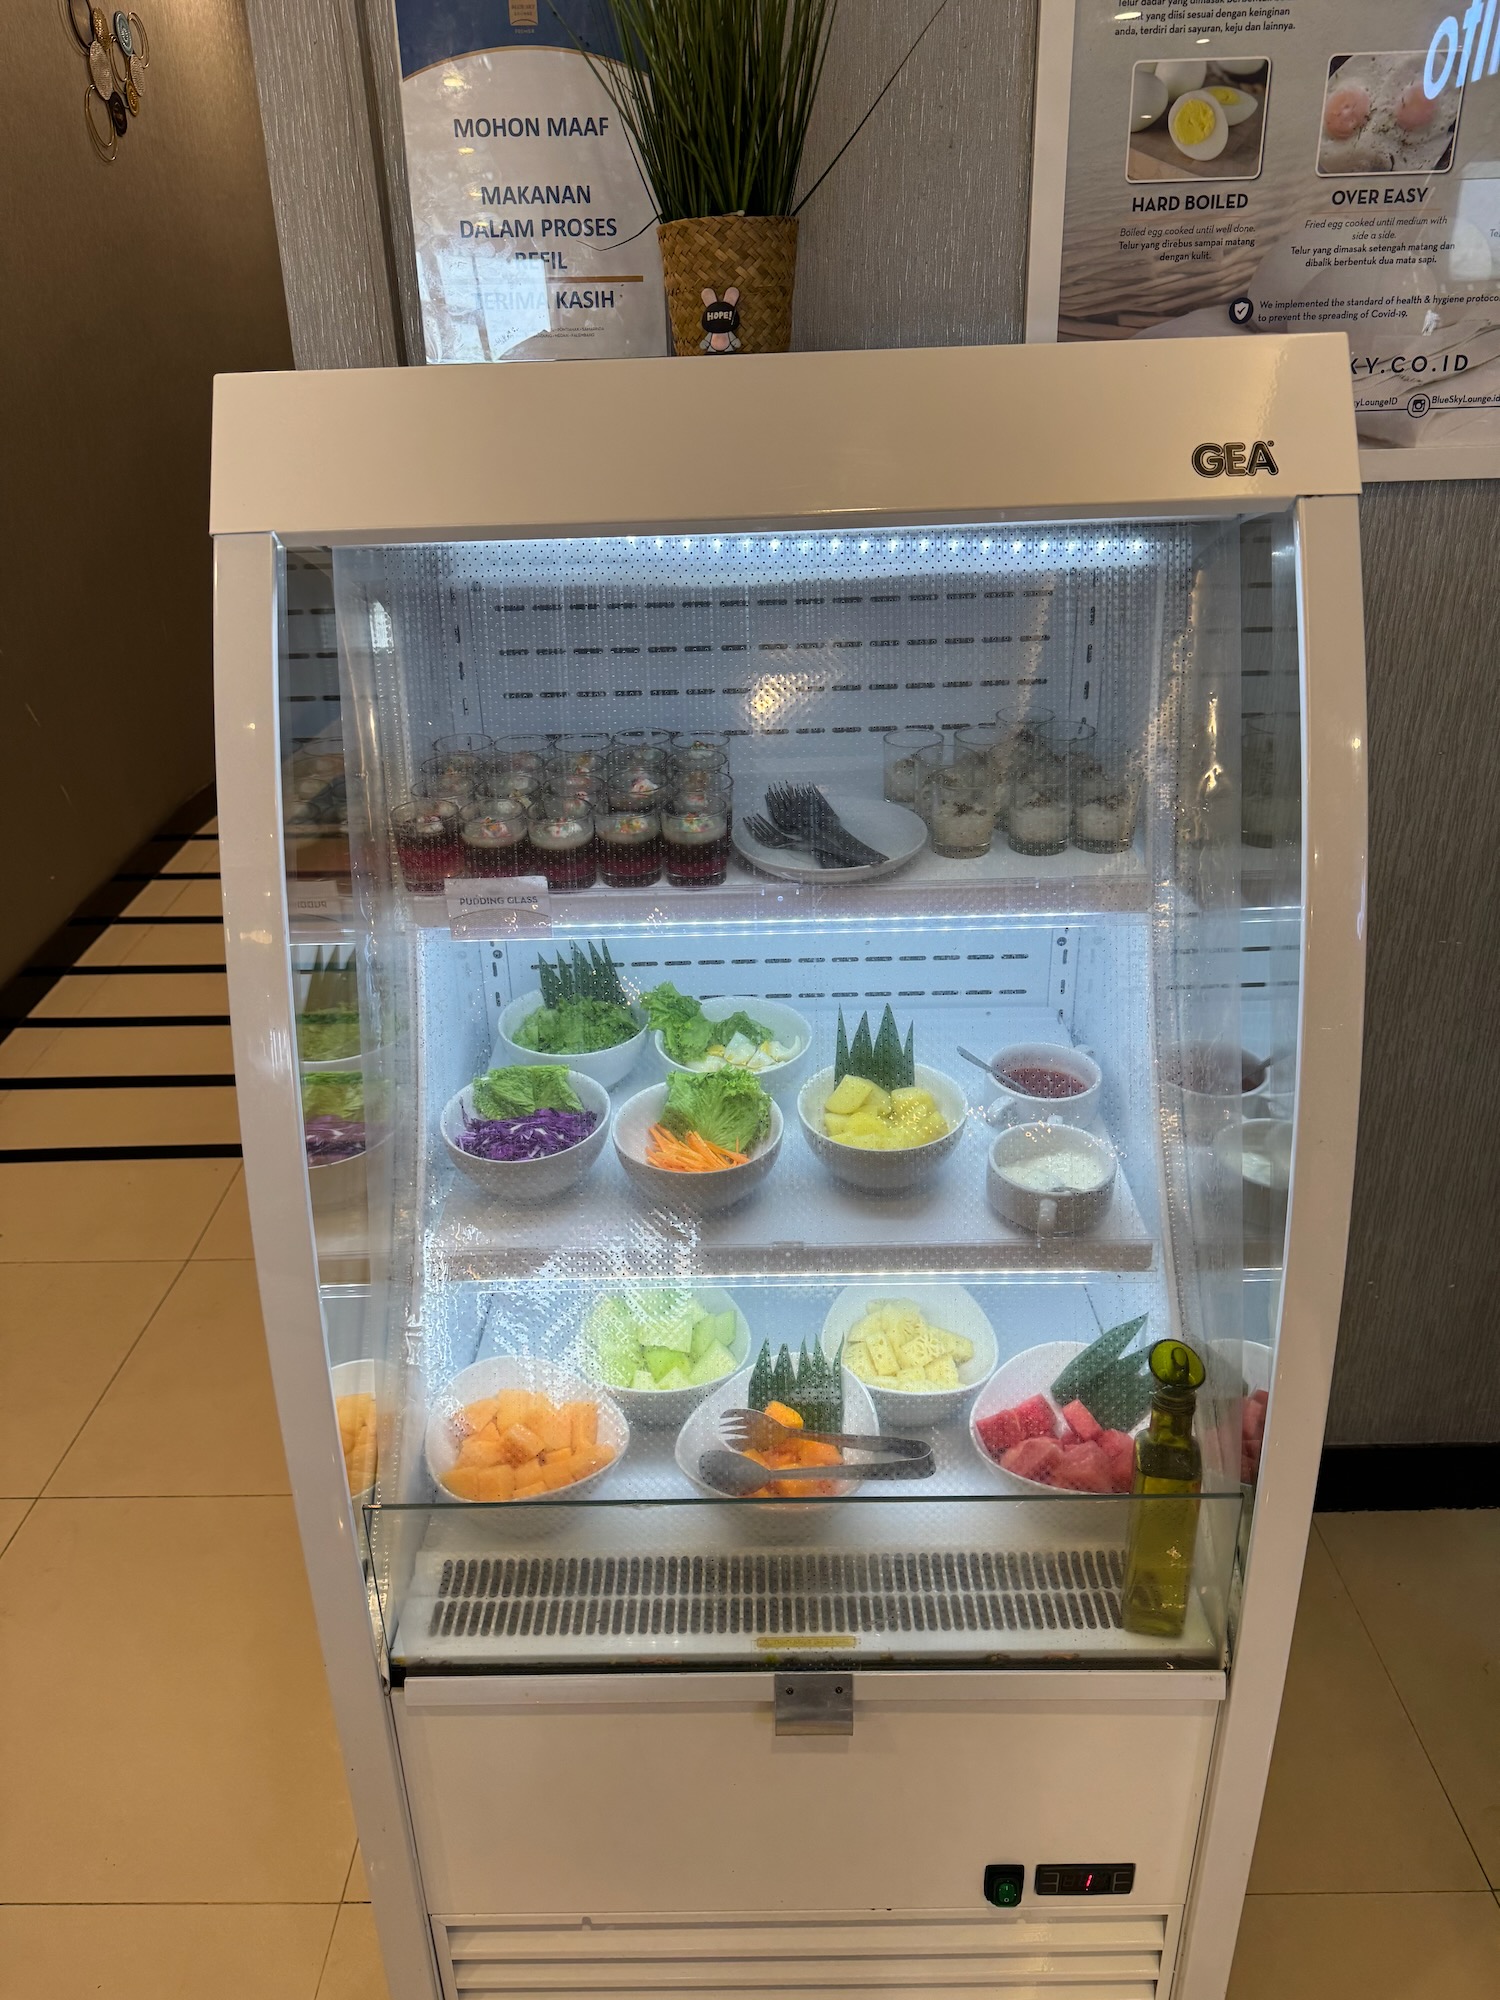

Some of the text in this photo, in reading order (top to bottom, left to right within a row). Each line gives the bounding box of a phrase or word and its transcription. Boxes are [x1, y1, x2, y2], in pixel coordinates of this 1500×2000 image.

[1146, 13, 1166, 22] yang
[1168, 10, 1186, 20] diisi
[1187, 9, 1214, 19] sesuai
[1215, 8, 1247, 19] dengan
[1249, 7, 1290, 18] keinginan
[1114, 21, 1296, 36] anda, terdiri dari sayuran, keju dan lainnya.
[453, 117, 609, 138] MOHON MAAF
[481, 185, 591, 205] MAKANAN
[1132, 193, 1249, 212] HARD BOILED
[1332, 187, 1429, 206] OVER EASY
[460, 218, 617, 239] DALAM PROSES
[1304, 215, 1448, 230] Fried egg cooked until medium with
[1120, 223, 1256, 238] Boiled egg cooked until well done.
[1351, 231, 1369, 240] side
[1378, 230, 1397, 239] side.
[1118, 237, 1256, 251] Telur yang direbus sampai matang
[1290, 241, 1456, 256] Telur yang dimasak setengah matang dan
[1159, 250, 1212, 262] dengan kulit.
[1305, 254, 1437, 267] dibalik berbentuk dua mata sapi.
[556, 290, 614, 309] KASIH
[1259, 300, 1273, 309] We
[1274, 298, 1329, 310] implemented
[1331, 297, 1346, 307] the
[1347, 296, 1383, 307] standard
[1385, 296, 1396, 306] of
[1396, 295, 1422, 305] health
[1424, 296, 1431, 304] &
[1432, 295, 1465, 306] hygiene
[707, 311, 733, 321] HOPE!
[1258, 309, 1408, 323] to prevent the spreading of Covid-19.
[460, 895, 538, 906] PUDDING GLASS
